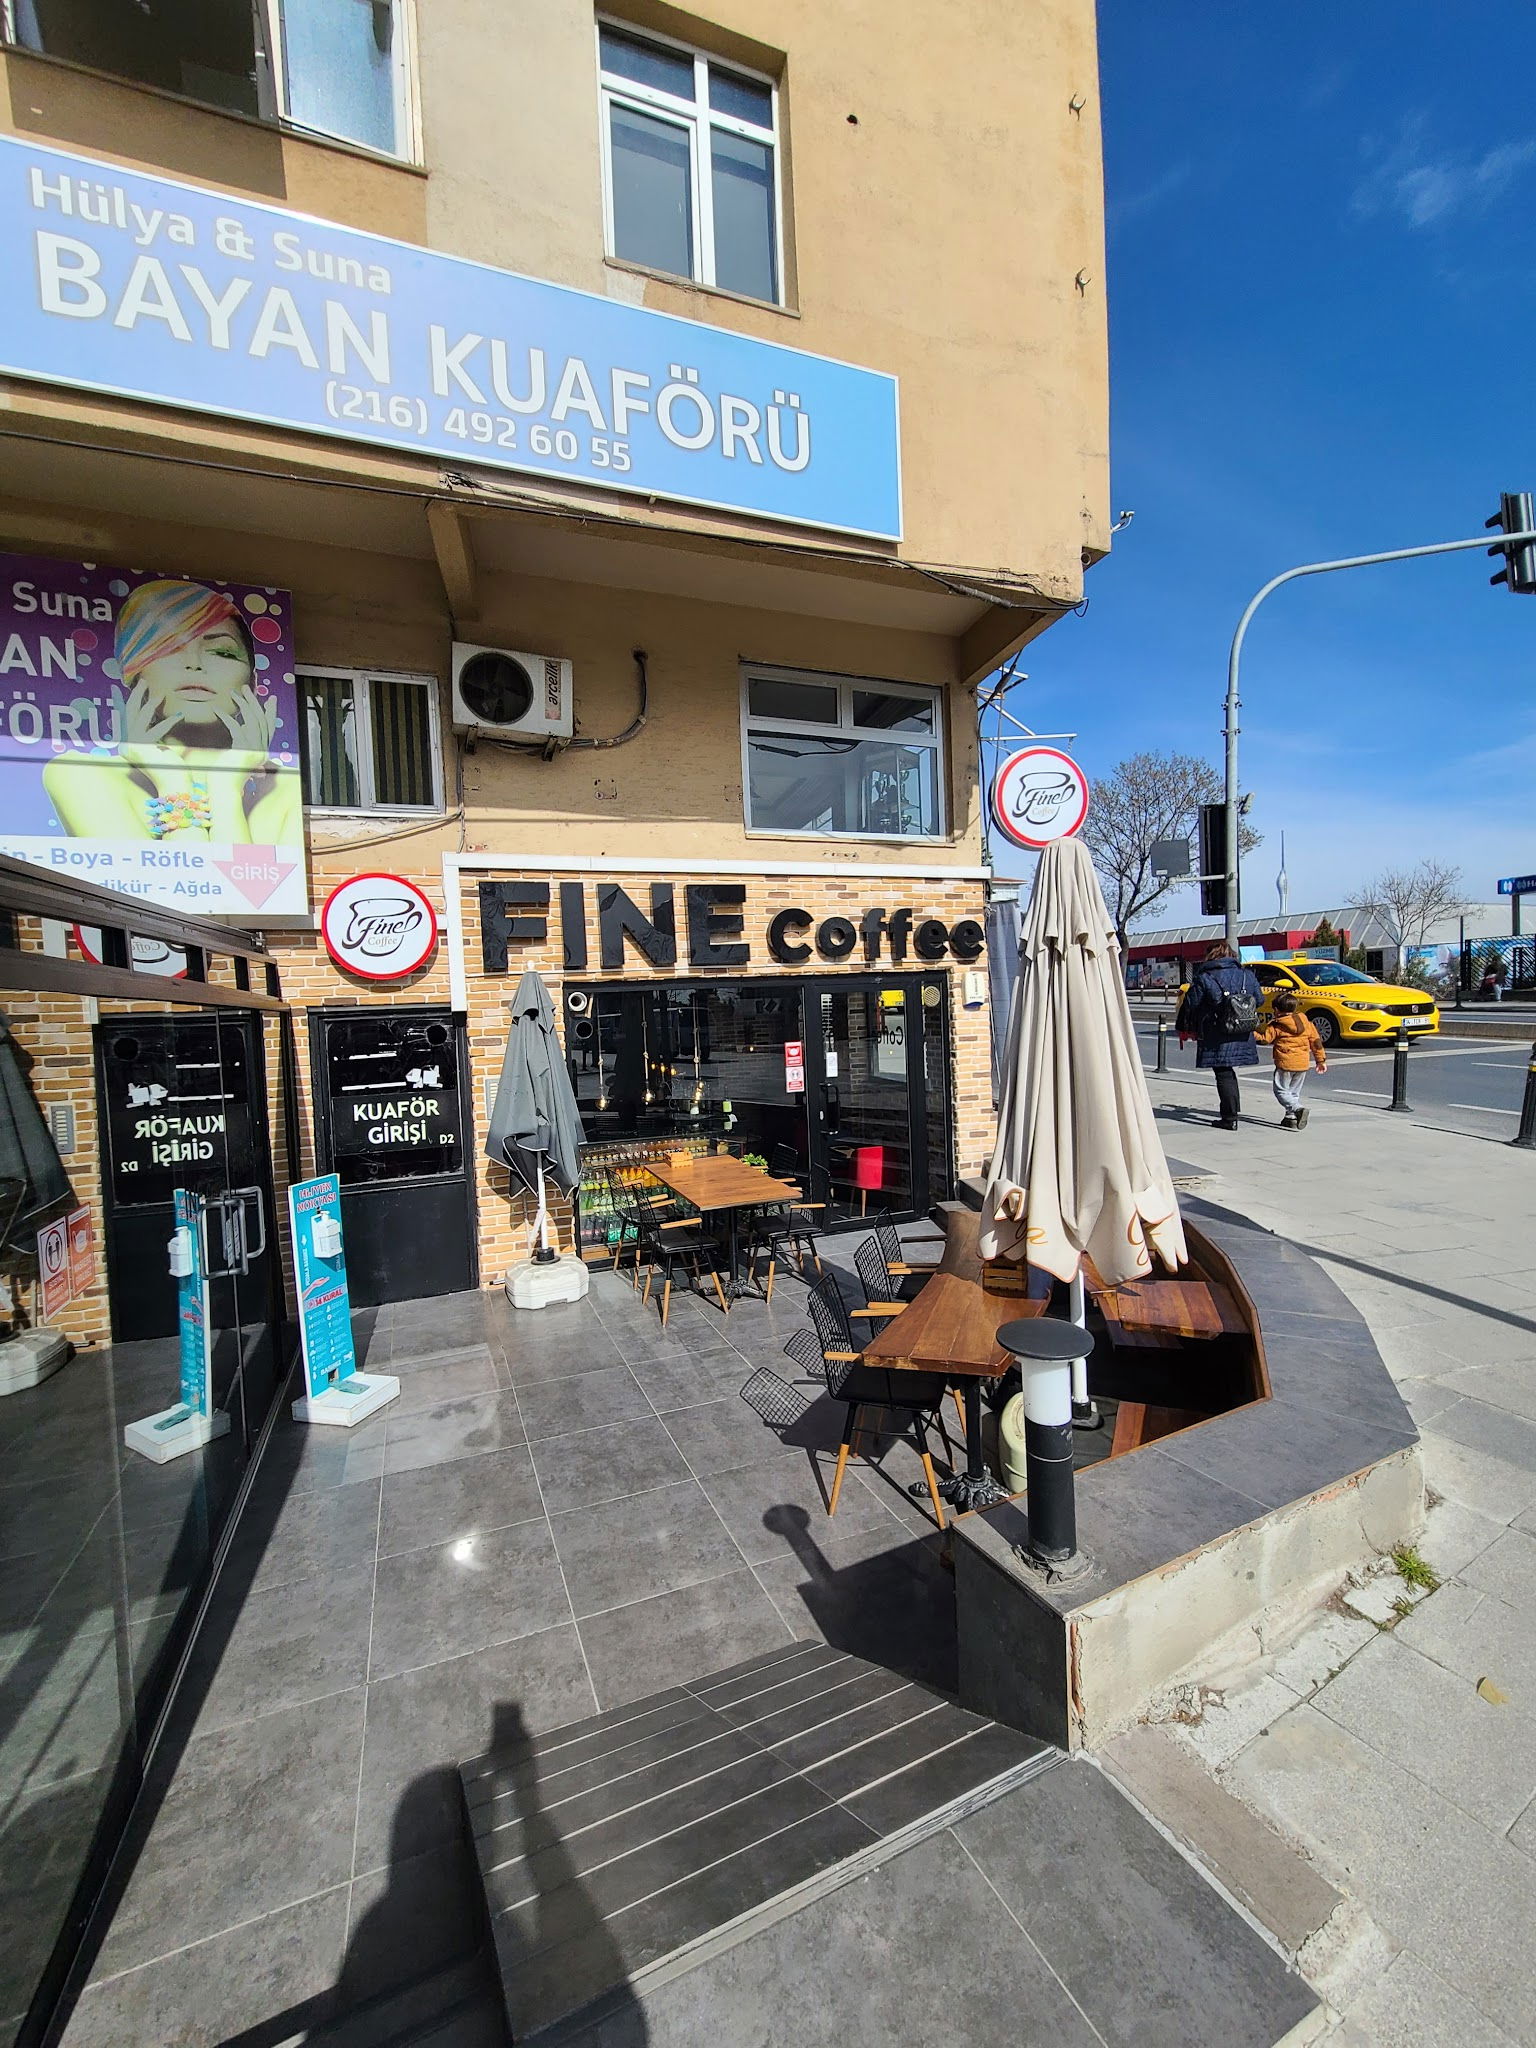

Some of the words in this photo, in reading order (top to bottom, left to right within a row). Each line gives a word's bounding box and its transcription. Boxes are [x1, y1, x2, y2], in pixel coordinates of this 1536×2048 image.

[30, 167, 195, 246] Hülya
[215, 217, 255, 261] &
[273, 231, 391, 295] Suna
[36, 230, 391, 384] BAYAN
[429, 324, 810, 472] KUAFÖRÜ
[326, 380, 429, 436] (216)
[443, 407, 518, 449] 492
[530, 424, 579, 461] 60
[591, 437, 632, 472] 55
[12, 581, 113, 622] Suna
[0, 633, 77, 680] AN
[51, 847, 113, 869] Boya
[141, 849, 204, 868] Röfle
[230, 862, 280, 883] GİRİŞ
[173, 881, 222, 898] Ağda
[478, 881, 750, 972] FINE
[767, 907, 986, 963] Coffee
[367, 935, 398, 948] Coffee
[353, 1096, 440, 1121] KUAFÖR
[368, 1120, 427, 1145] GİRİŞİ
[439, 1134, 455, 1145] D2
